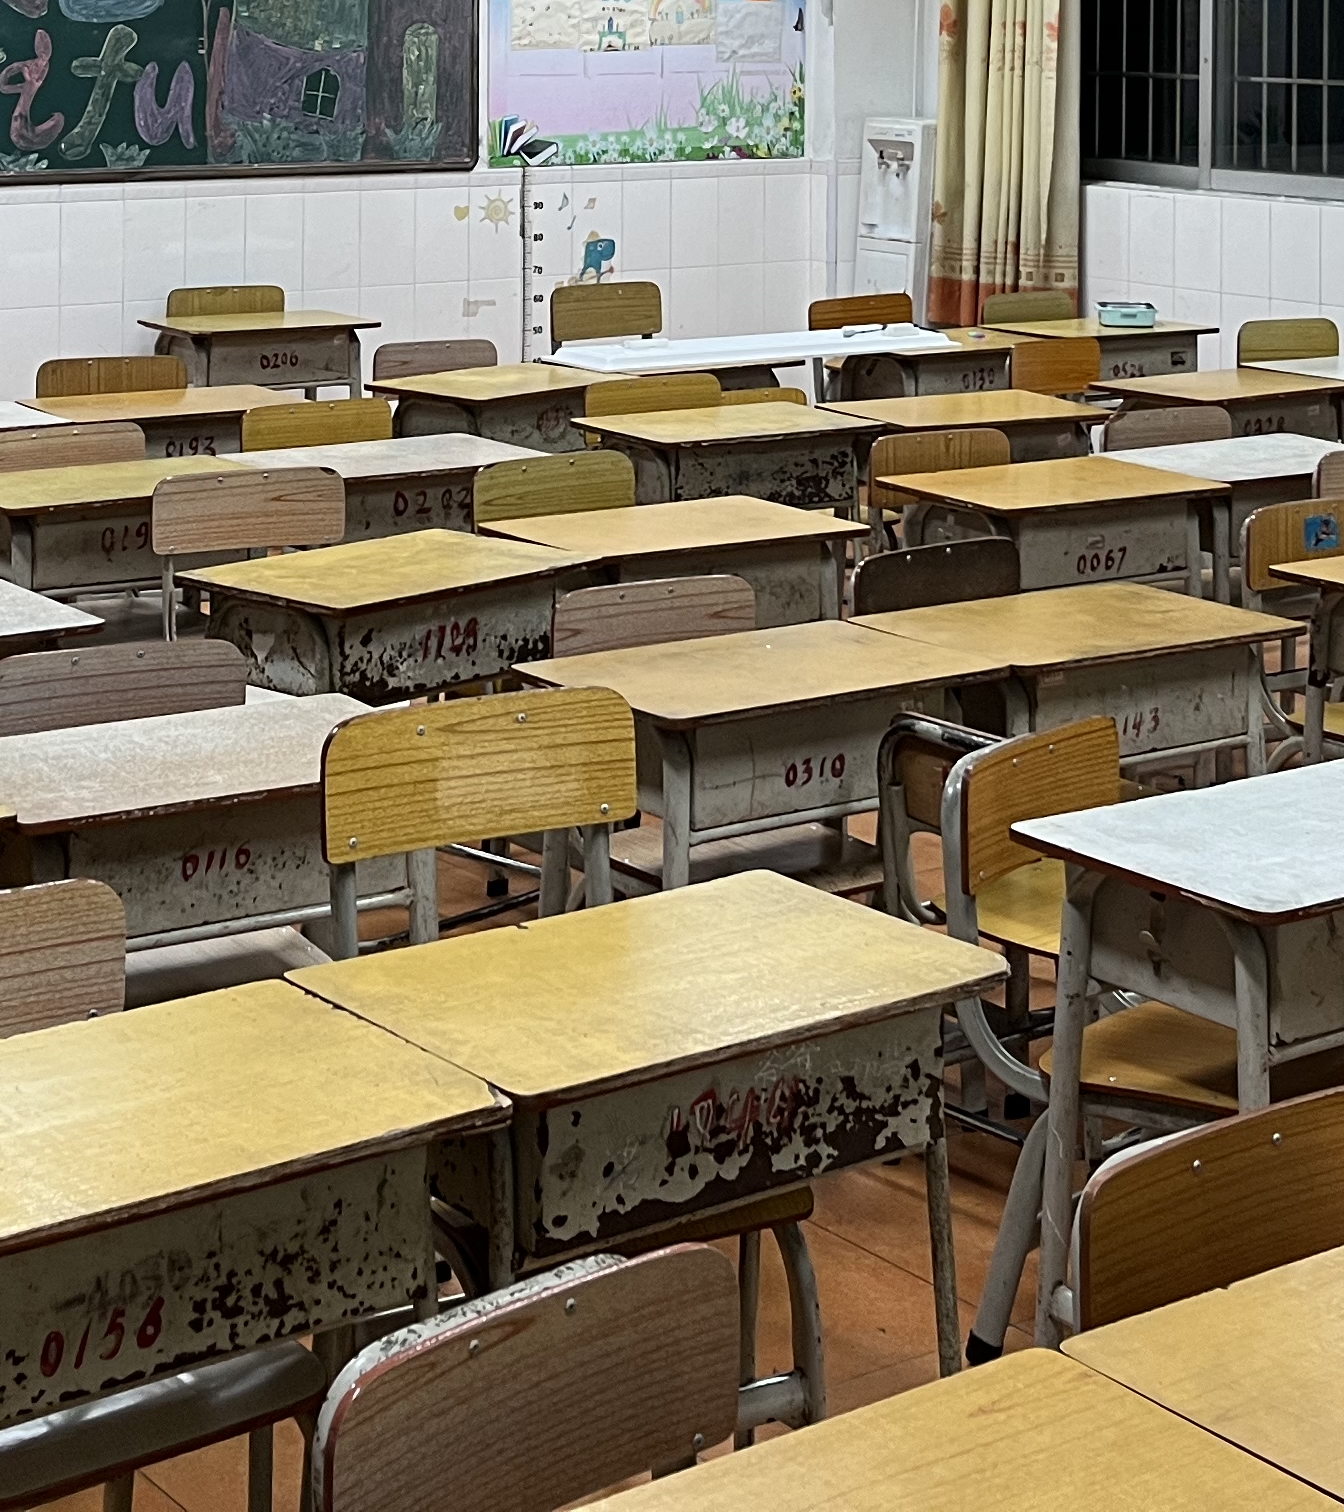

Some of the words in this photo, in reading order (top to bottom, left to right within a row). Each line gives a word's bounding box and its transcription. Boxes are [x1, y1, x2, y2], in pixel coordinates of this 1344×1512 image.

[532, 265, 543, 275] 70
[532, 325, 543, 335] 50
[1076, 546, 1127, 574] 0067
[785, 753, 846, 787] 0310
[40, 1295, 165, 1378] 0156
